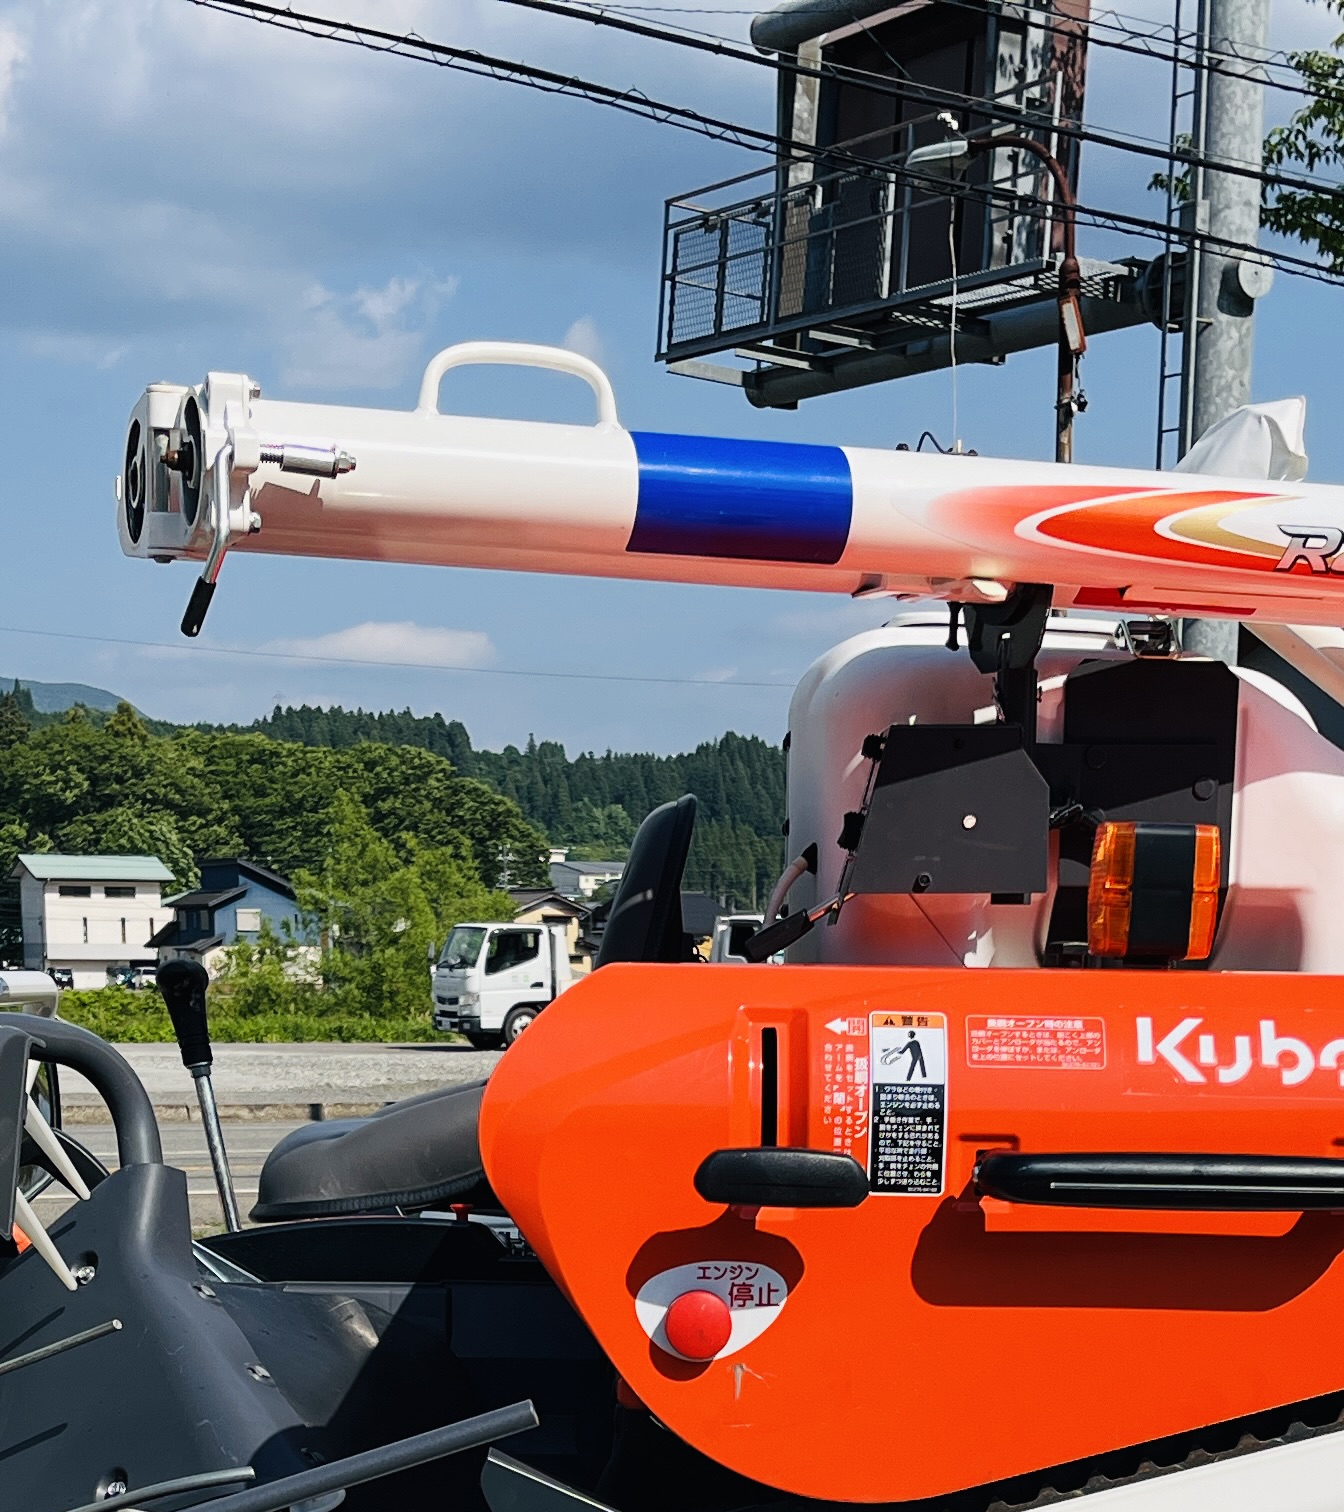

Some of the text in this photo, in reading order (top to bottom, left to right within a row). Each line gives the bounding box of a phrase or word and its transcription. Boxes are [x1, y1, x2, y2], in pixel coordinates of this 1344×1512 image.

[901, 1016, 929, 1027] 警告
[696, 1265, 759, 1280] エンジン
[728, 1282, 780, 1307] 停止
